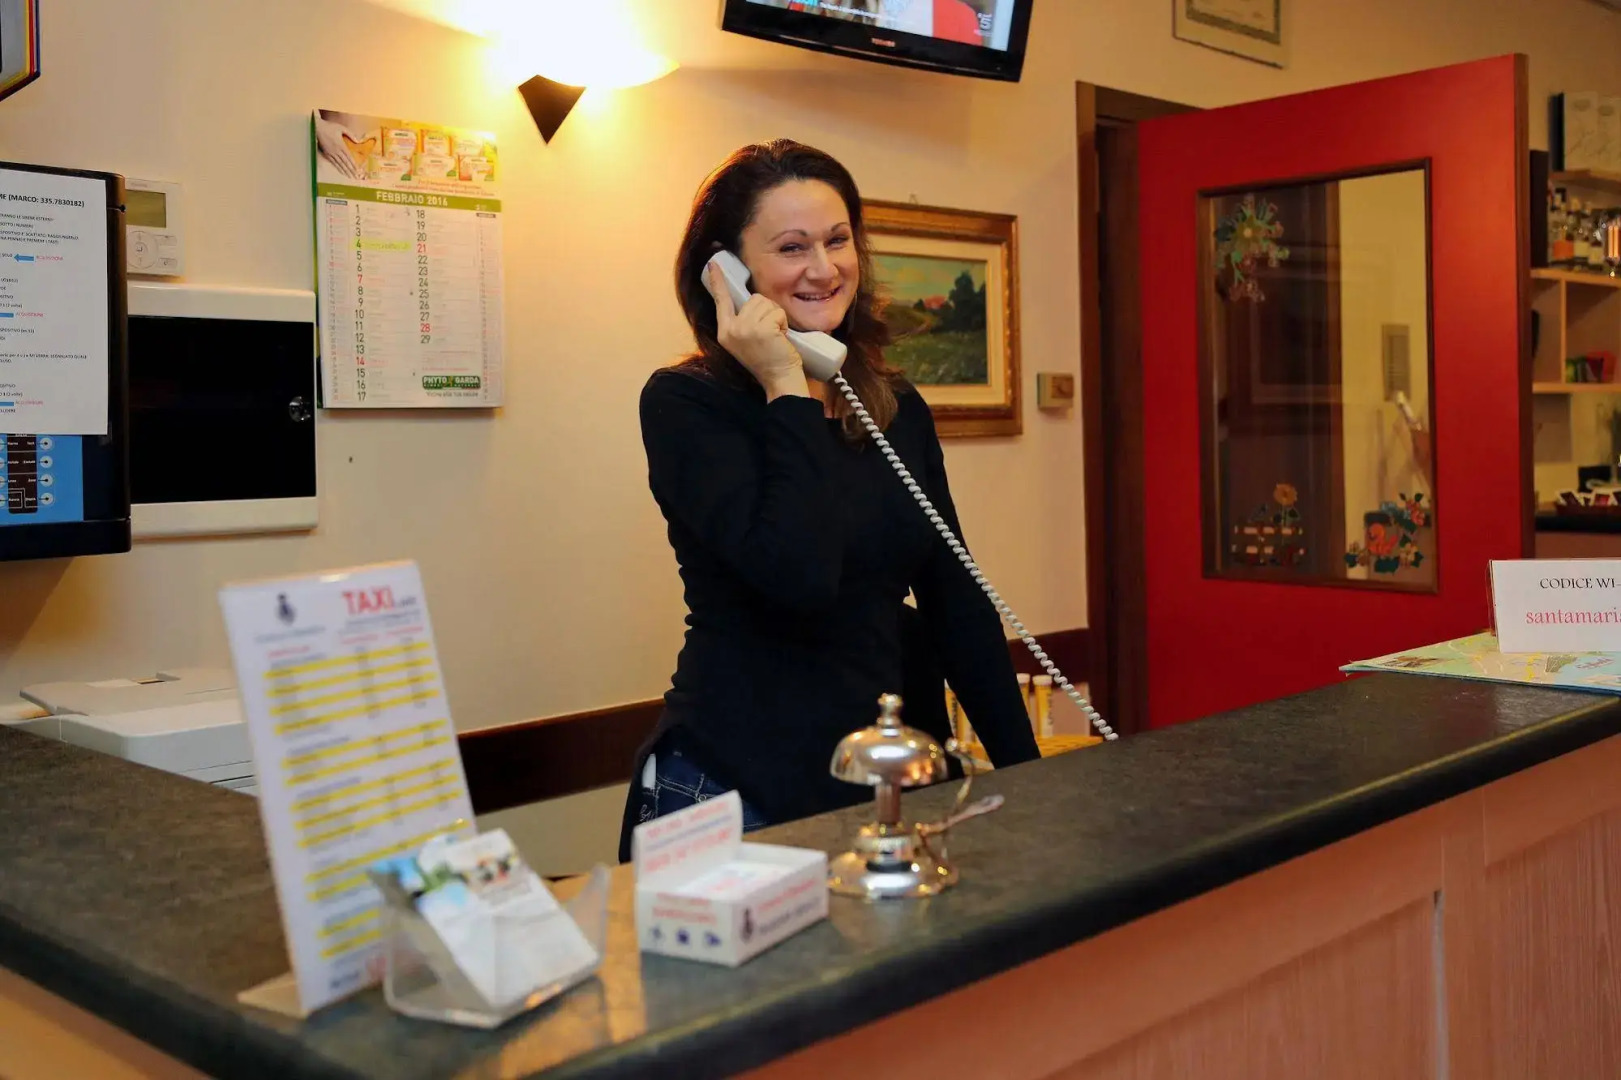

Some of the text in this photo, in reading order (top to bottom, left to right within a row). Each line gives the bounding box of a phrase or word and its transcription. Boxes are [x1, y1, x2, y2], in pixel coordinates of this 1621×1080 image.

[8, 194, 39, 203] (MARCO:
[376, 191, 448, 207] FEBBRAIO 2016
[356, 205, 359, 213] 1
[417, 210, 425, 218] 18
[356, 217, 360, 225] 2
[417, 222, 425, 230] 19
[356, 228, 360, 236] 3
[417, 233, 427, 242] 20
[356, 240, 361, 248] 4
[418, 244, 426, 253] 21
[357, 251, 361, 260] 5
[418, 256, 428, 264] 22
[357, 263, 362, 271] 6
[418, 267, 428, 276] 23
[358, 275, 362, 283] 7
[419, 278, 428, 287] 24
[358, 287, 363, 295] 8
[419, 290, 429, 299] 25
[358, 298, 363, 306] 9
[420, 301, 429, 309] 26
[355, 310, 364, 318] 10
[420, 313, 429, 321] 27
[356, 322, 362, 330] 11
[420, 324, 430, 332] 28
[356, 333, 364, 342] 12
[420, 336, 430, 344] 29
[356, 345, 364, 354] 13
[357, 357, 365, 365] 14
[357, 369, 365, 377] 15
[357, 380, 365, 389] 16
[358, 392, 366, 401] 17
[1540, 578, 1593, 589] CODICE
[342, 586, 395, 616] TAXI
[1526, 607, 1621, 624] santamari
